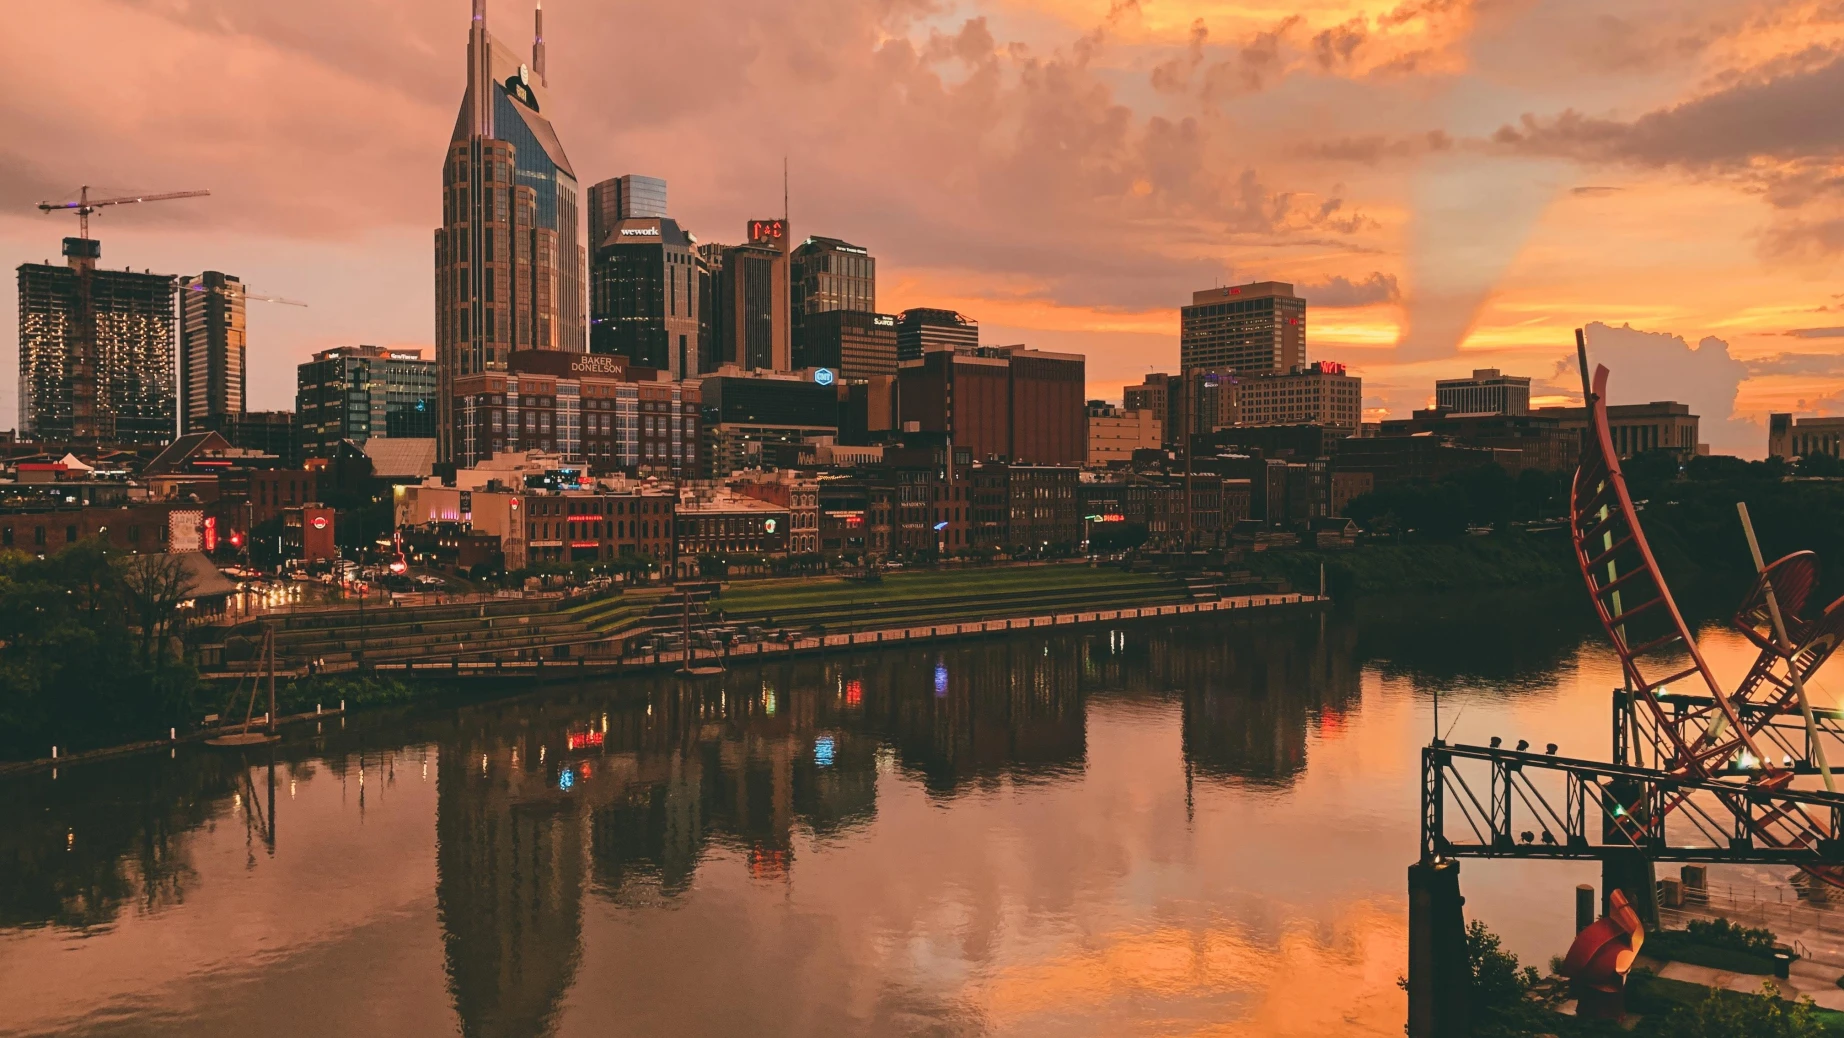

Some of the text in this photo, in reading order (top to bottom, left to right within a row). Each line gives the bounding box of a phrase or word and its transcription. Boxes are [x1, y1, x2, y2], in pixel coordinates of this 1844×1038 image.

[620, 226, 659, 236] wework
[581, 355, 612, 366] BAKER
[571, 362, 622, 374] DONELSON
